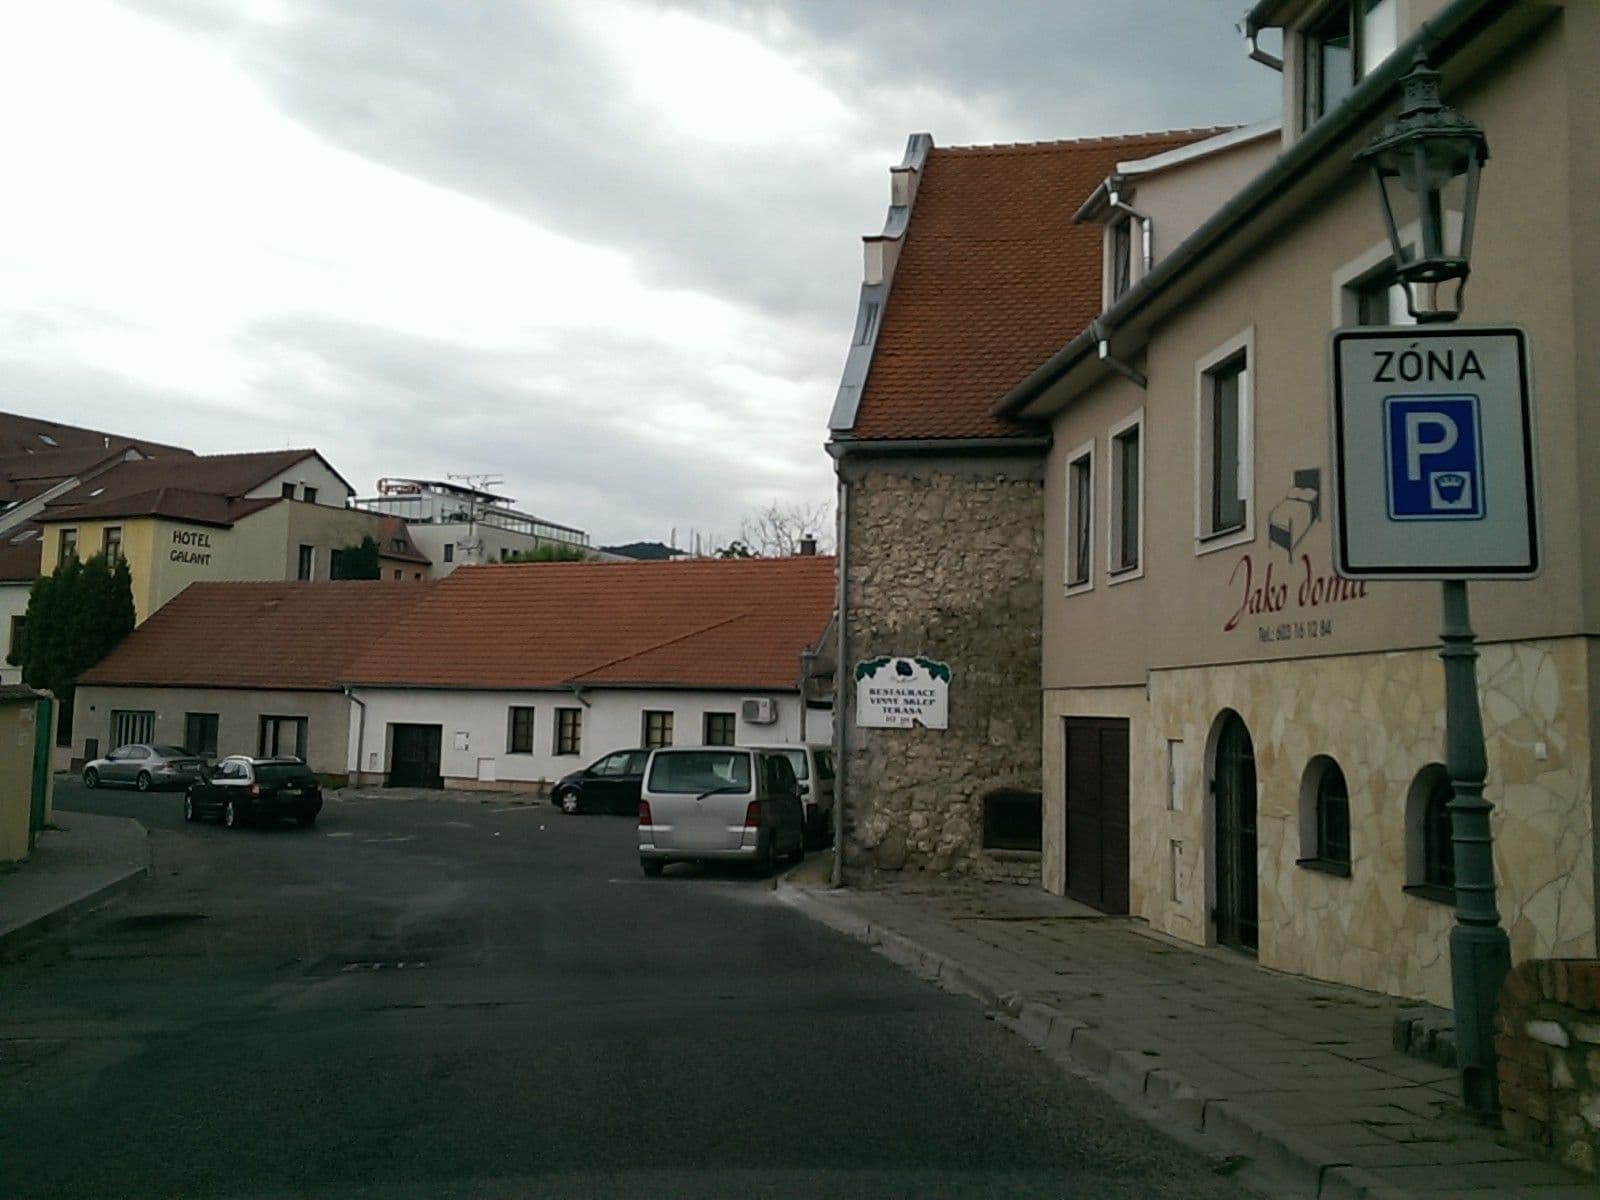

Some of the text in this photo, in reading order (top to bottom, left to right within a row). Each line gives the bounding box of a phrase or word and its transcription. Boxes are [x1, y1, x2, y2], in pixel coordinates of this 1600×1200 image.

[1373, 342, 1486, 382] ZÓNA
[1405, 411, 1459, 481] P
[172, 530, 211, 548] HOTEL
[170, 549, 211, 566] GALANT
[1223, 554, 1288, 632] Jako
[869, 687, 937, 697] RESTAURACE
